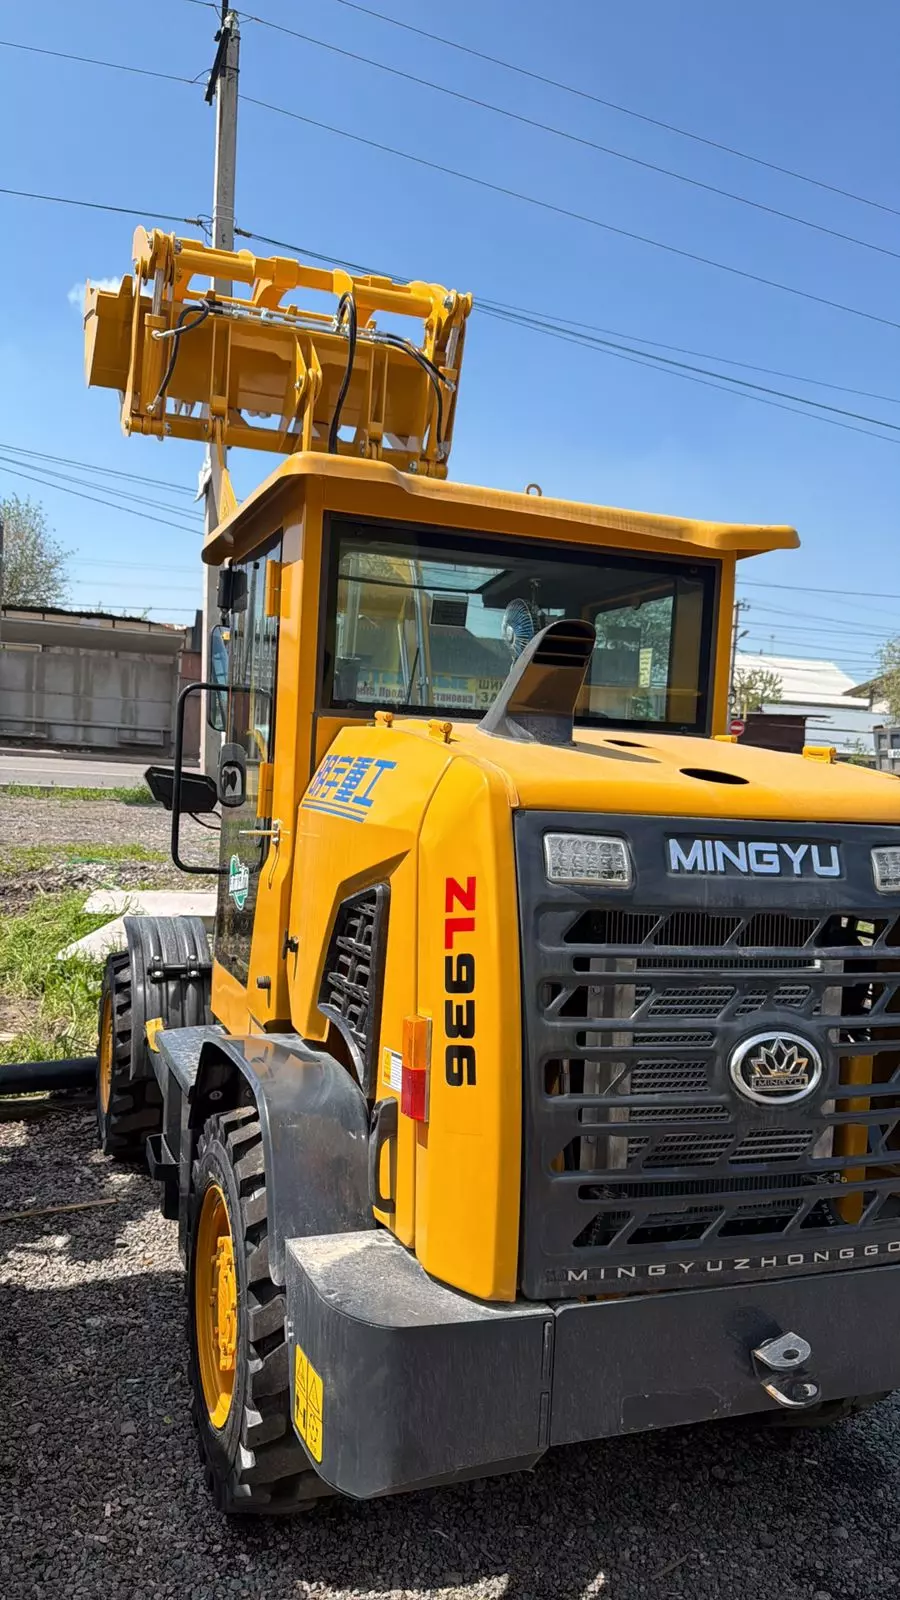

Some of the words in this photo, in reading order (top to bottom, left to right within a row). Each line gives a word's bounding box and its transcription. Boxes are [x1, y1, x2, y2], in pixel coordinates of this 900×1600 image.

[668, 838, 841, 877] MINGYU
[758, 1078, 802, 1087] MINGYU
[567, 1240, 900, 1281] MINGYUZHONGGO
